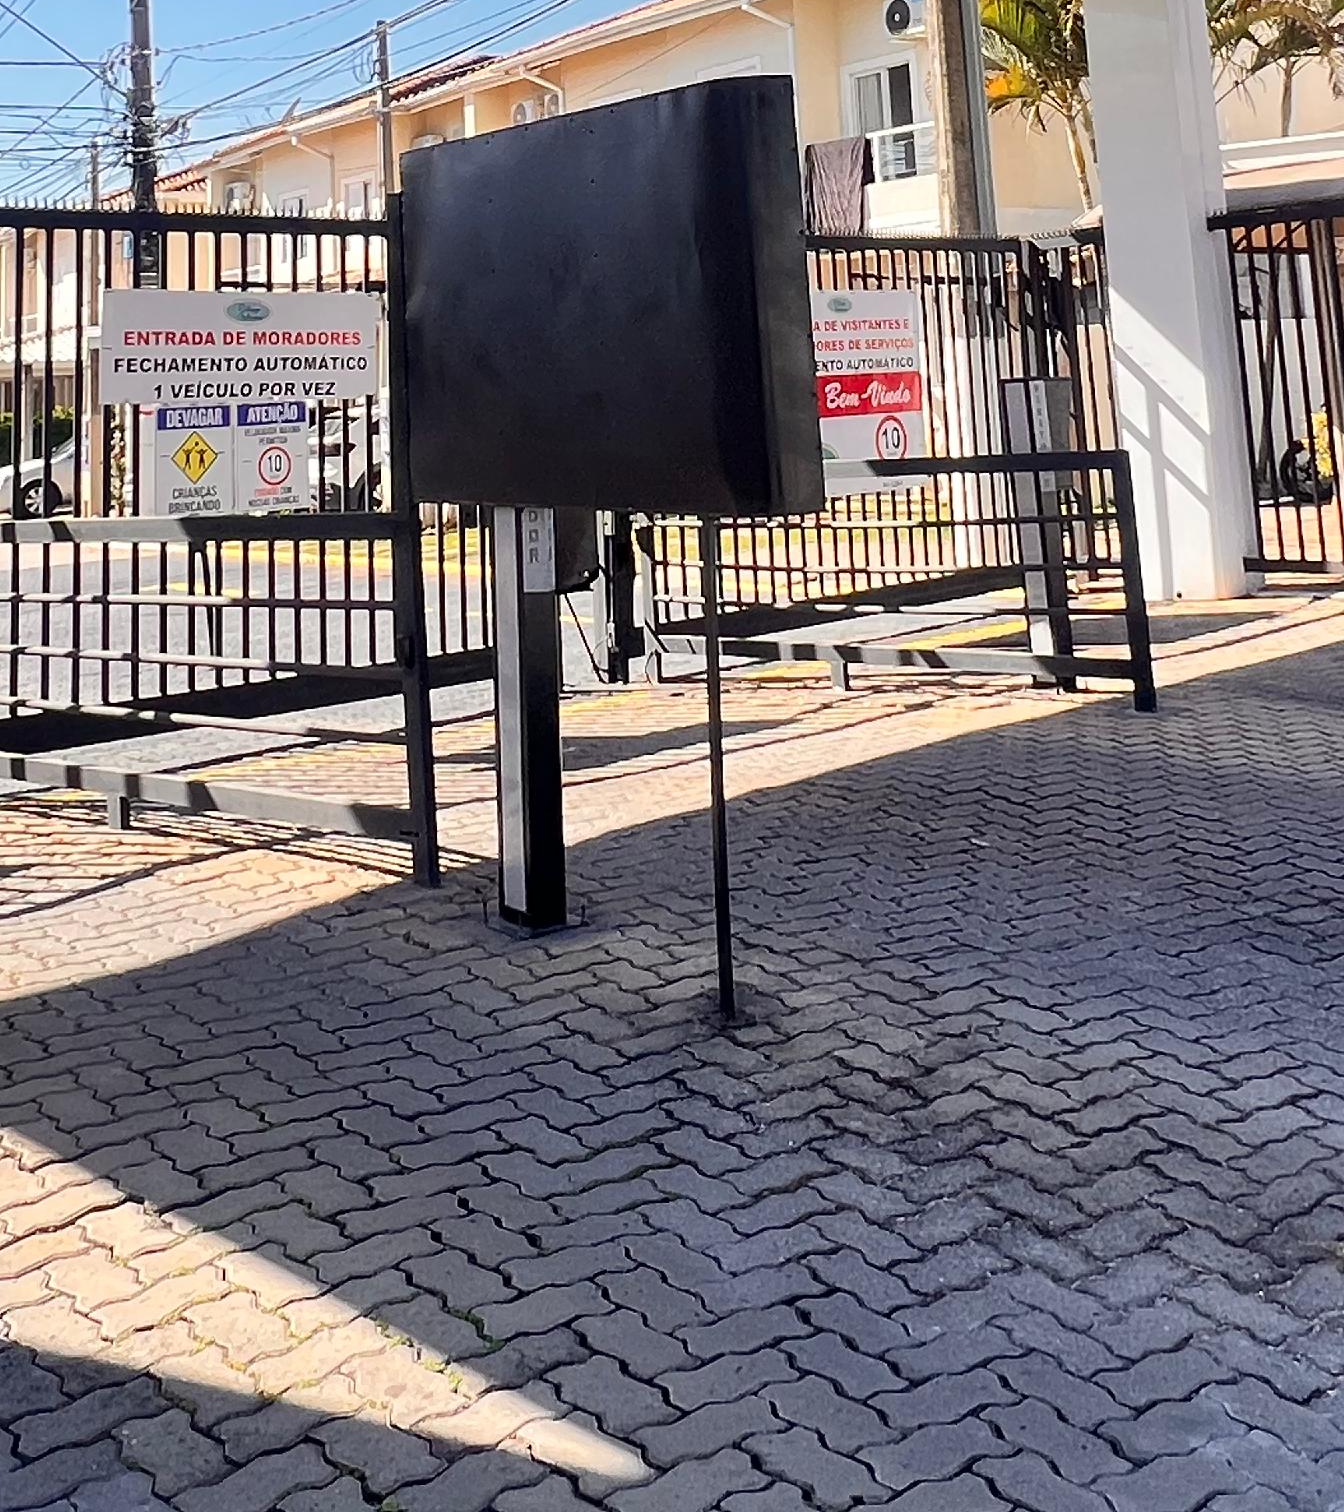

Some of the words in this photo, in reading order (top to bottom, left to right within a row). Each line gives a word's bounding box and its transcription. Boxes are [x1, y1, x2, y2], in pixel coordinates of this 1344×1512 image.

[824, 321, 837, 331] DE
[840, 319, 901, 331] VISITANTES
[903, 319, 909, 329] E
[124, 331, 216, 347] ENTRADA
[222, 331, 246, 346] DE
[253, 331, 361, 346] MORADORES
[815, 341, 844, 351] ORES
[848, 339, 861, 349] DE
[865, 338, 913, 351] SERVIÇOS
[114, 357, 248, 373] FECHAMENTO
[253, 354, 368, 371] AUTOMÁTICO
[154, 384, 162, 399] 1
[171, 379, 253, 399] VEÍCULO
[259, 382, 295, 397] POR
[302, 381, 336, 396] VEZ
[166, 408, 223, 428] DEVAGAR
[247, 402, 298, 424] ATENÇÃO
[881, 426, 901, 450] 10
[267, 454, 282, 473] 10
[172, 485, 218, 499] CRIANÇAS
